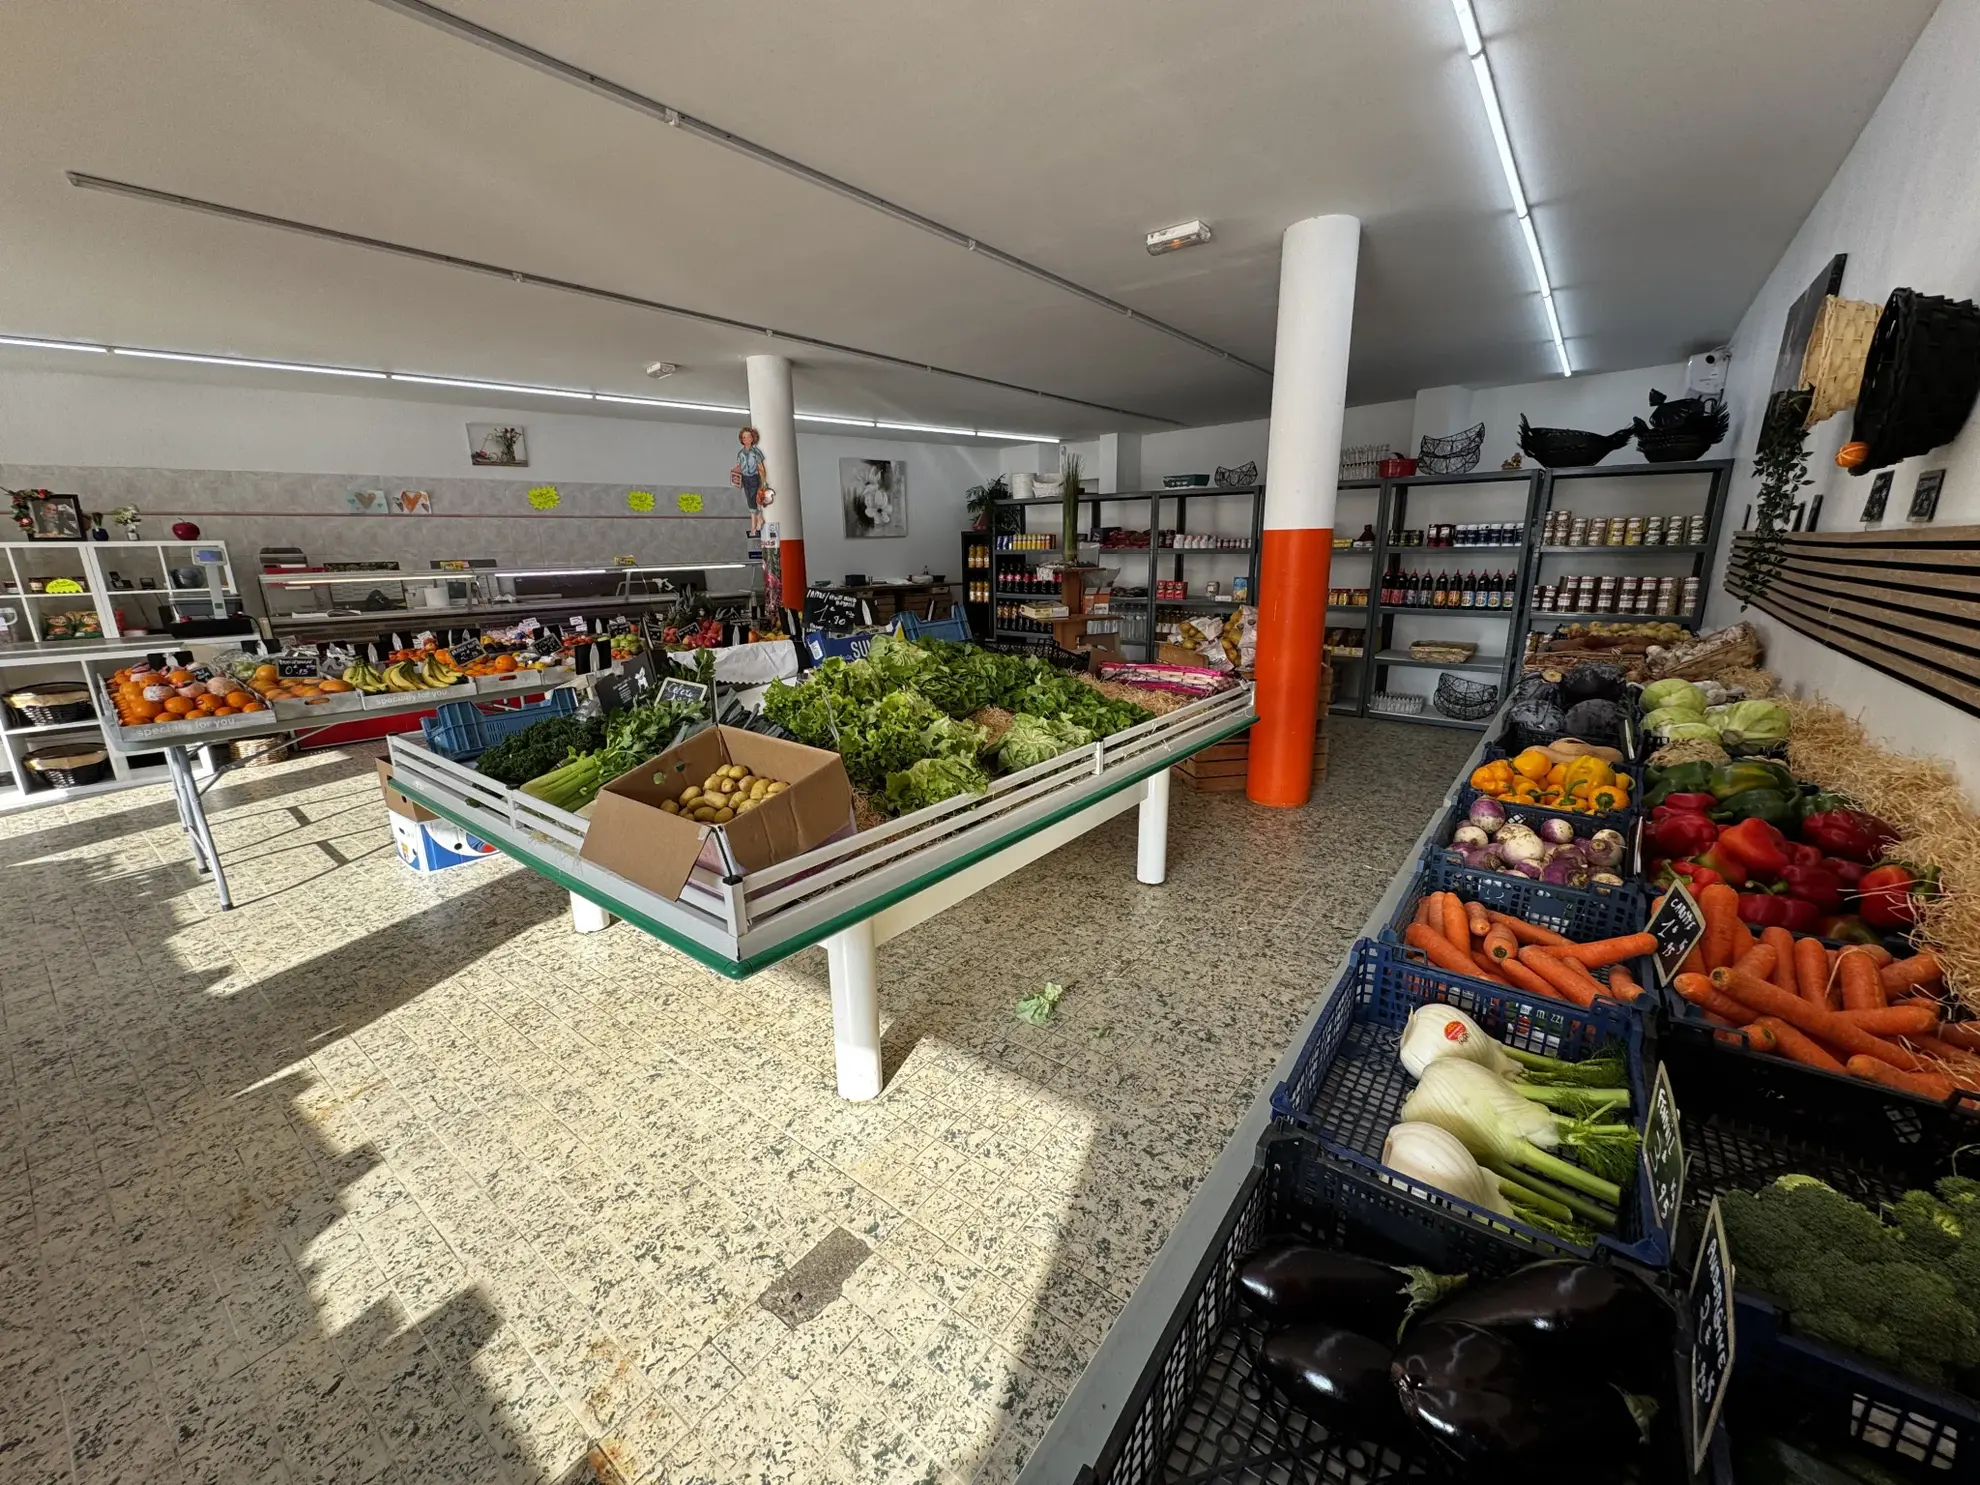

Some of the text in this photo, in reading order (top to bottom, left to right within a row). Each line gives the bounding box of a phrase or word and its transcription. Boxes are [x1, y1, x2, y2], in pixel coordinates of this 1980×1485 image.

[376, 694, 416, 706] specially
[417, 691, 430, 699] for
[135, 722, 192, 738] specially
[194, 719, 213, 730] for
